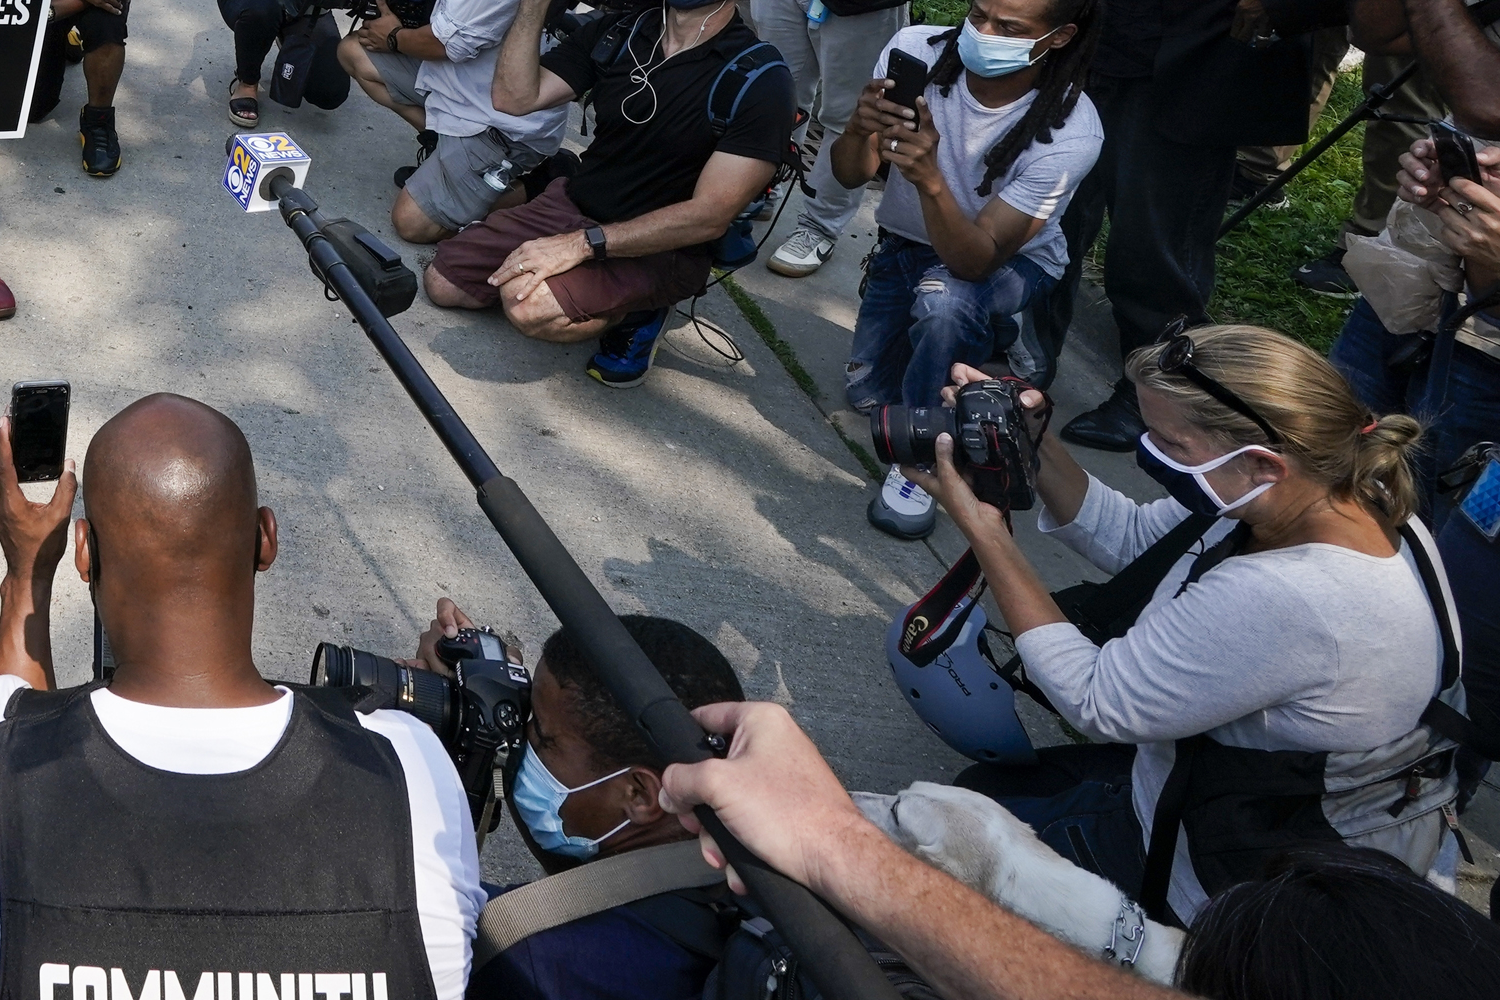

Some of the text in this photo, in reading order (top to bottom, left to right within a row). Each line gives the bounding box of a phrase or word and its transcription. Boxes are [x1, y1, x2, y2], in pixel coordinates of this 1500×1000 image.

[258, 150, 303, 160] NEWS
[268, 135, 296, 152] 2
[233, 146, 251, 175] 2
[239, 159, 257, 204] NEWS
